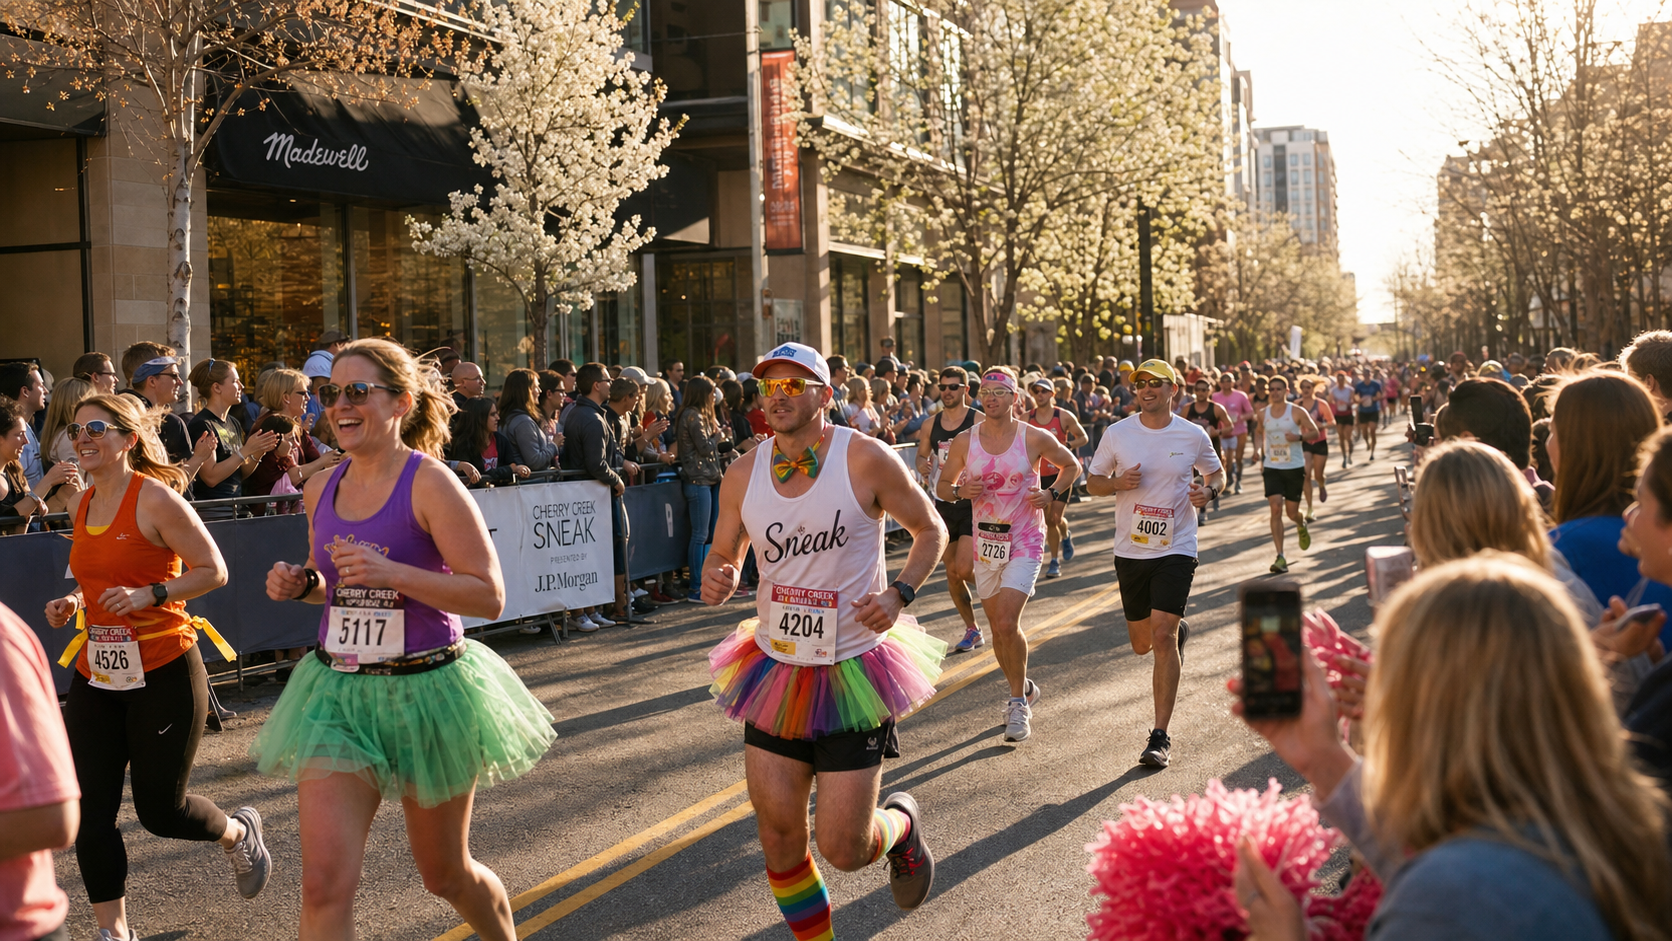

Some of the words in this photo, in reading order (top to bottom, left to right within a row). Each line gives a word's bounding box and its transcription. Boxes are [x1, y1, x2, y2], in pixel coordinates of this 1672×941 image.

[263, 132, 369, 171] Madewell
[533, 502, 570, 520] CHERRY
[572, 501, 596, 516] CREEK
[533, 516, 596, 549] SNEAK
[764, 509, 849, 563] Sneak
[1136, 520, 1167, 536] 4002
[982, 543, 1006, 560] 2726
[338, 617, 387, 646] 5117
[779, 612, 824, 639] 4204
[95, 650, 129, 669] 4526
